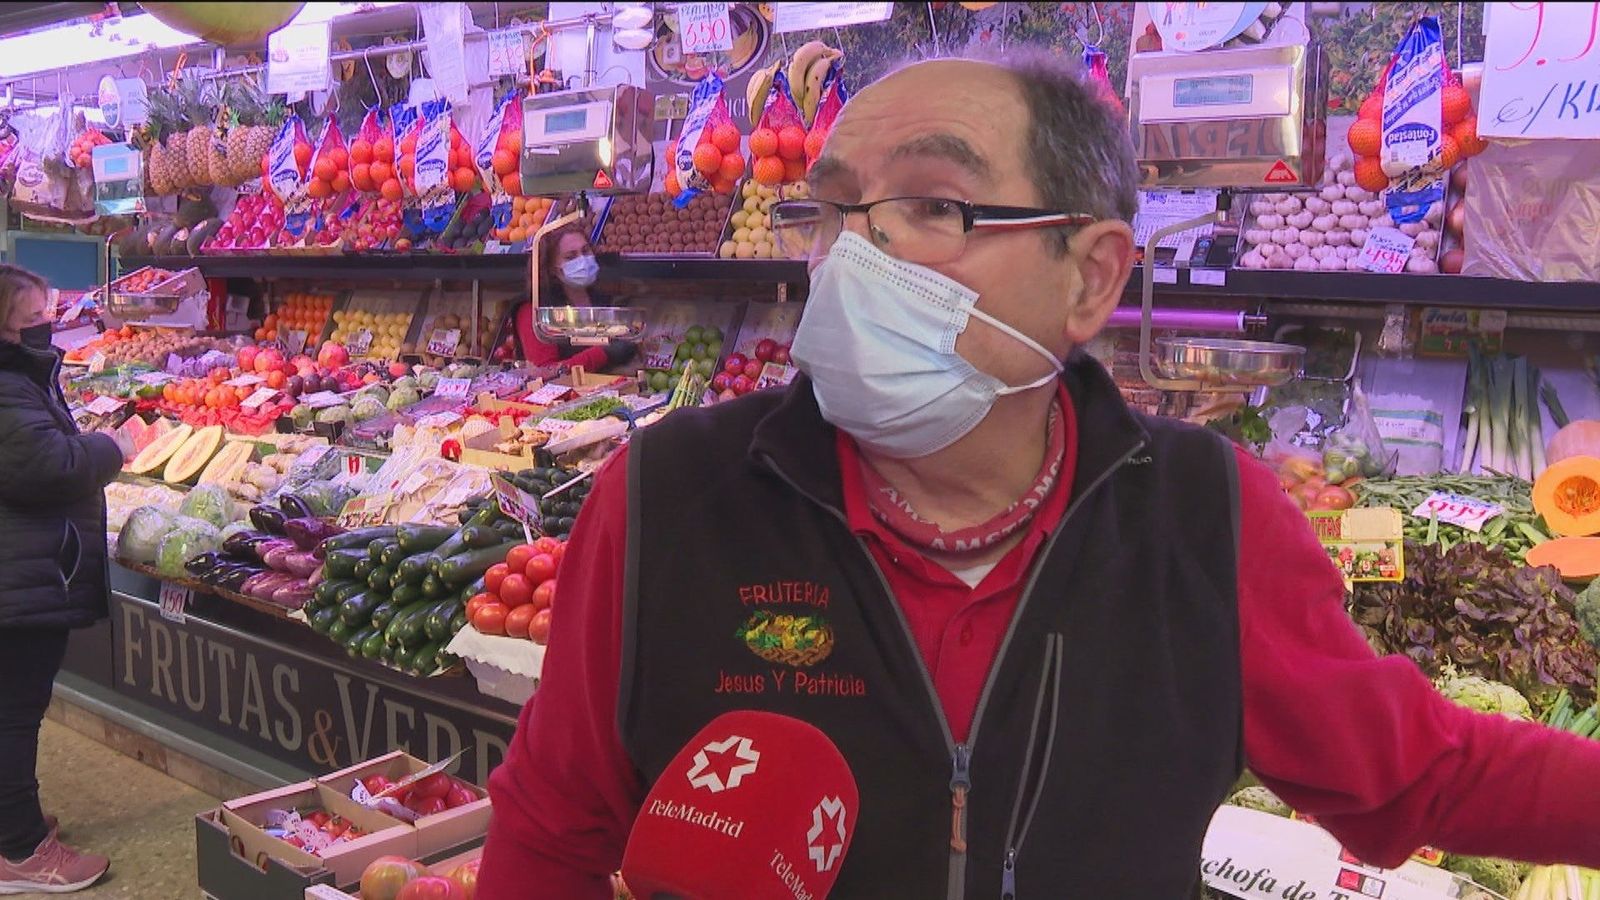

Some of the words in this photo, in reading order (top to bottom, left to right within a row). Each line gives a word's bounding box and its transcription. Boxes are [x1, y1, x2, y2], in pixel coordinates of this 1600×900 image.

[1388, 128, 1435, 141] Fontestad
[739, 582, 831, 608] FRUTERIA
[121, 602, 300, 751] FRUTAS
[307, 709, 343, 768] &
[714, 670, 765, 693] Jesus
[772, 670, 786, 691] Y
[794, 672, 866, 696] Patricia
[648, 799, 744, 838] TeleMadrid
